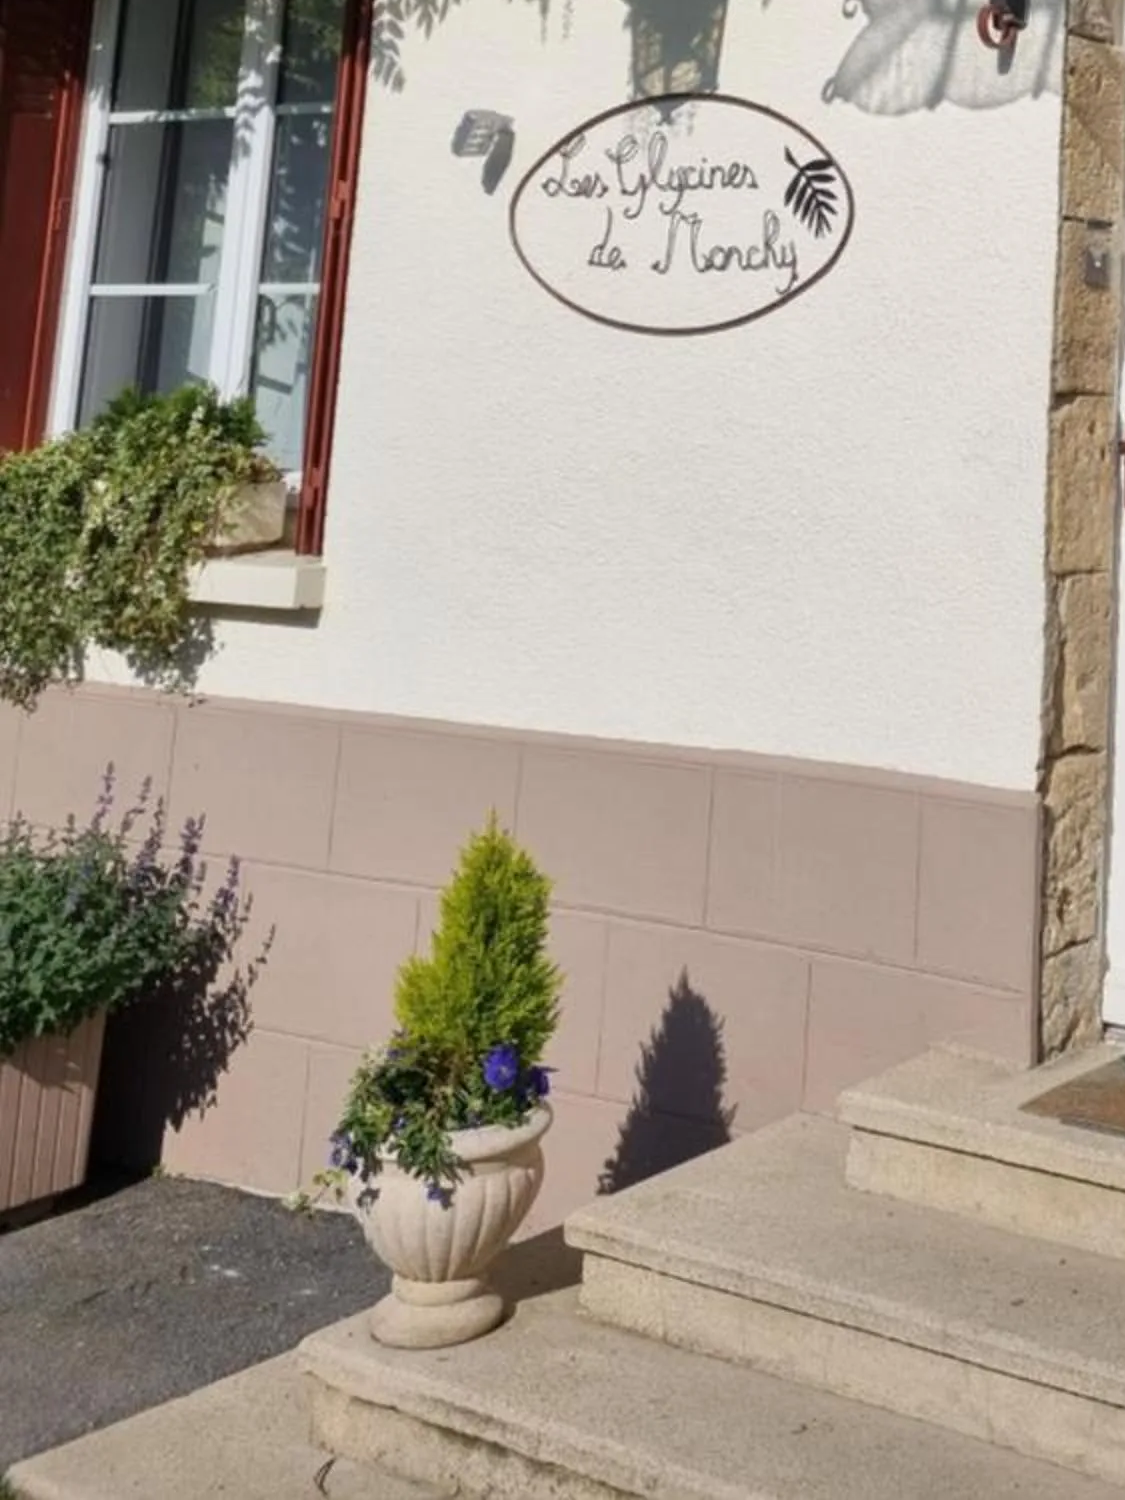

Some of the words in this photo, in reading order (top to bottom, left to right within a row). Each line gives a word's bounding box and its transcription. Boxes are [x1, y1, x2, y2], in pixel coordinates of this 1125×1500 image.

[541, 133, 609, 198] Les
[606, 130, 759, 219] Glycines
[587, 205, 627, 271] de
[651, 209, 799, 296] Monchy
